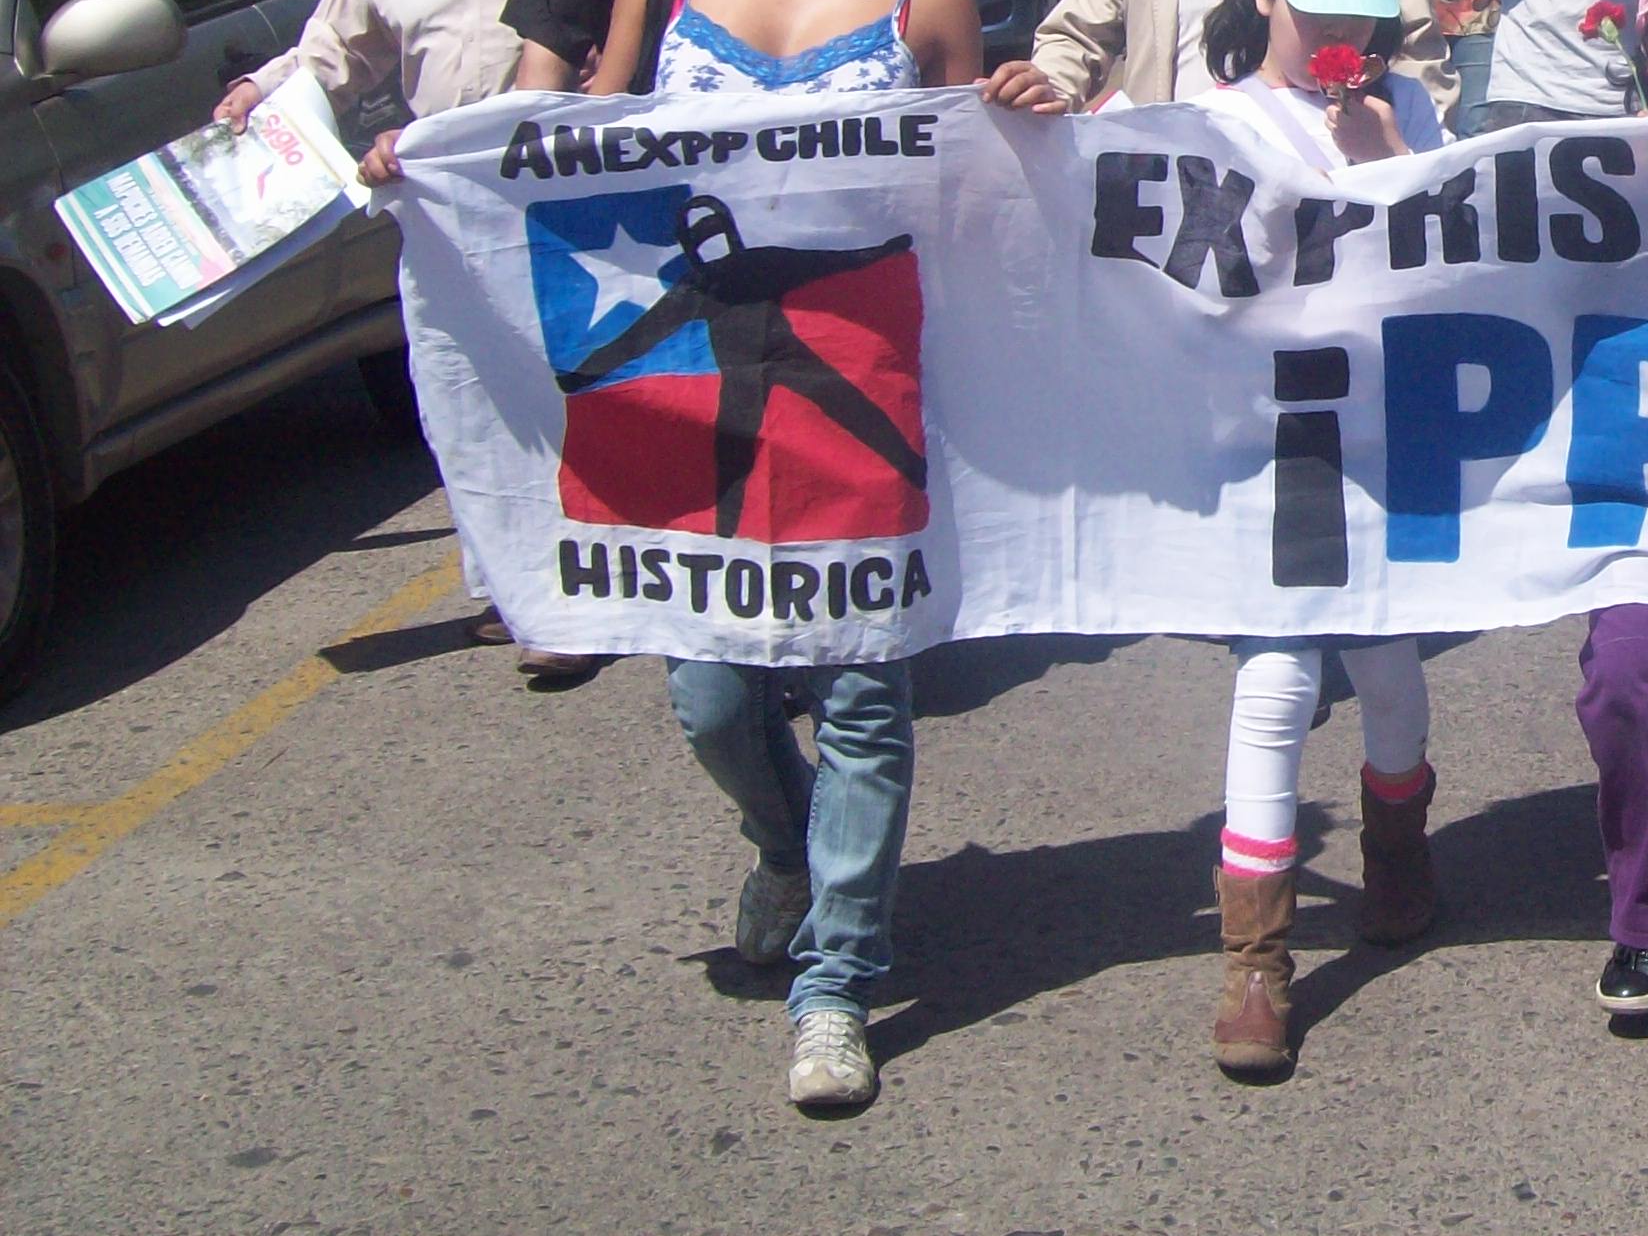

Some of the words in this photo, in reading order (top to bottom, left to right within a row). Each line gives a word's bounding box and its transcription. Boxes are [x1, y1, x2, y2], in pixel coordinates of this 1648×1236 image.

[500, 120, 749, 180] ANEXPP
[756, 114, 939, 162] CHILE
[1091, 151, 1261, 298] EX
[558, 540, 932, 622] HISTORICA
